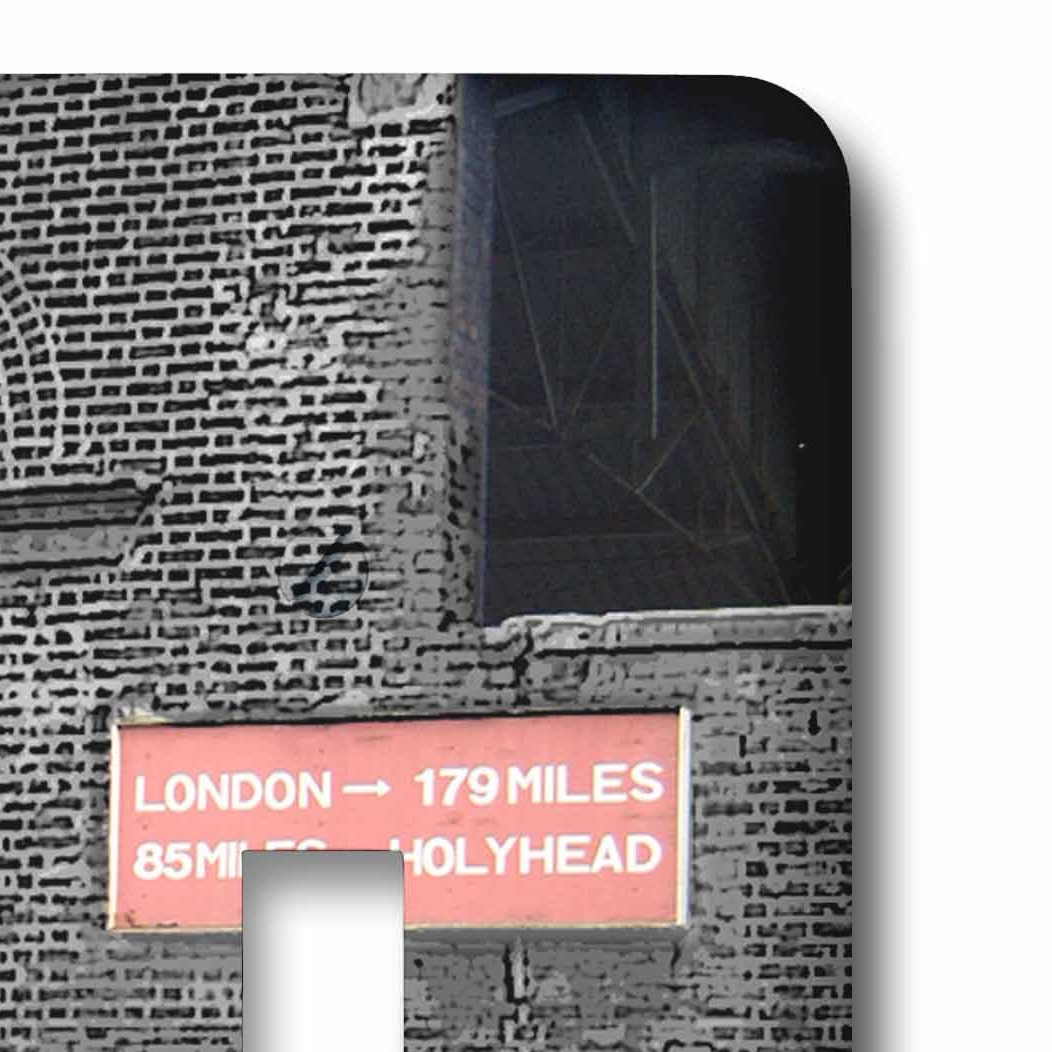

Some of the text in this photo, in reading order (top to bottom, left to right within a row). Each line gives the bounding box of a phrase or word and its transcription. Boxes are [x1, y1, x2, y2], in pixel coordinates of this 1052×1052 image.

[134, 761, 664, 812] LONDON 179 MILES
[134, 841, 193, 880] 85
[390, 834, 662, 876] HOLYHEAD
